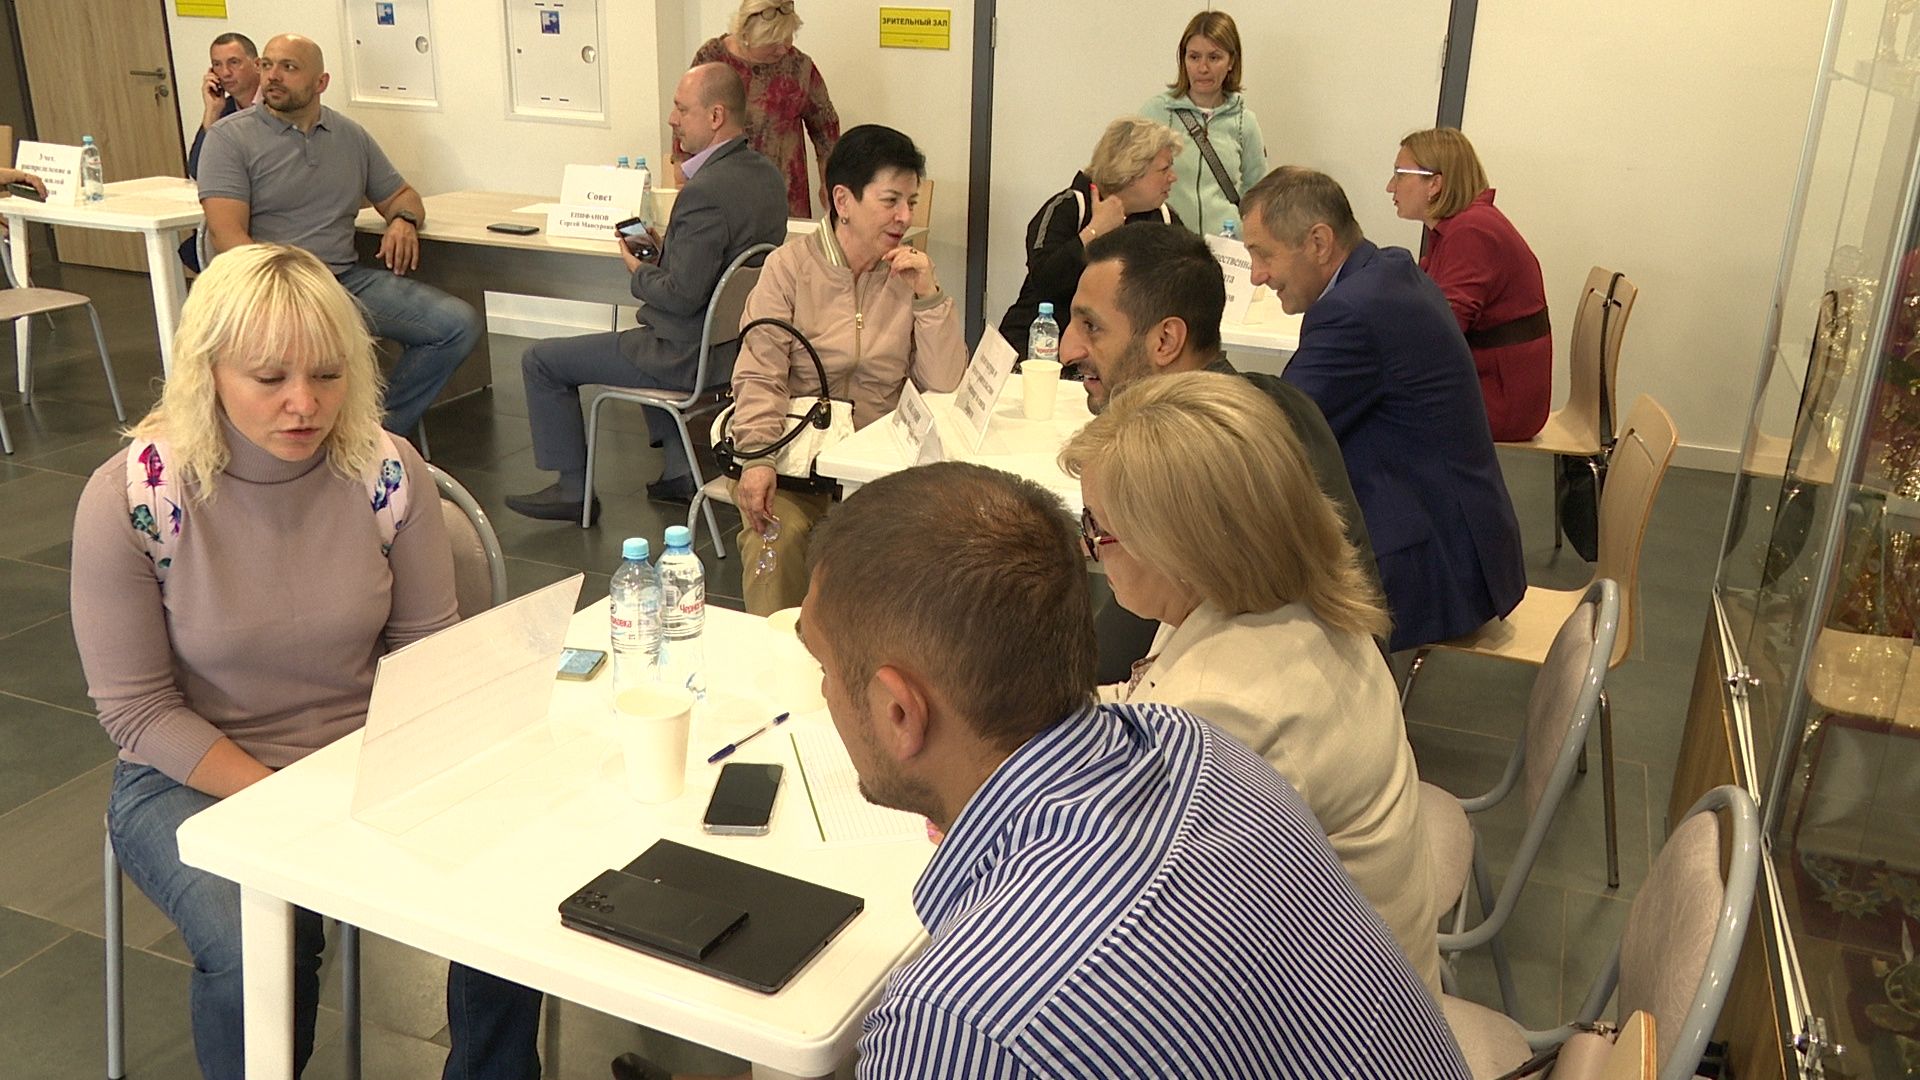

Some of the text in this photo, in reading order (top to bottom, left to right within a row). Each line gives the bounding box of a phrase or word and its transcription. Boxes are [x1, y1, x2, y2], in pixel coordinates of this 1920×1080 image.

[882, 17, 948, 27] ЗРИТЕЛЬНЫЙ ЗАЛ
[587, 191, 612, 202] Совет
[570, 211, 609, 221] ЕПИФАНОВ
[559, 219, 580, 228] Сергей
